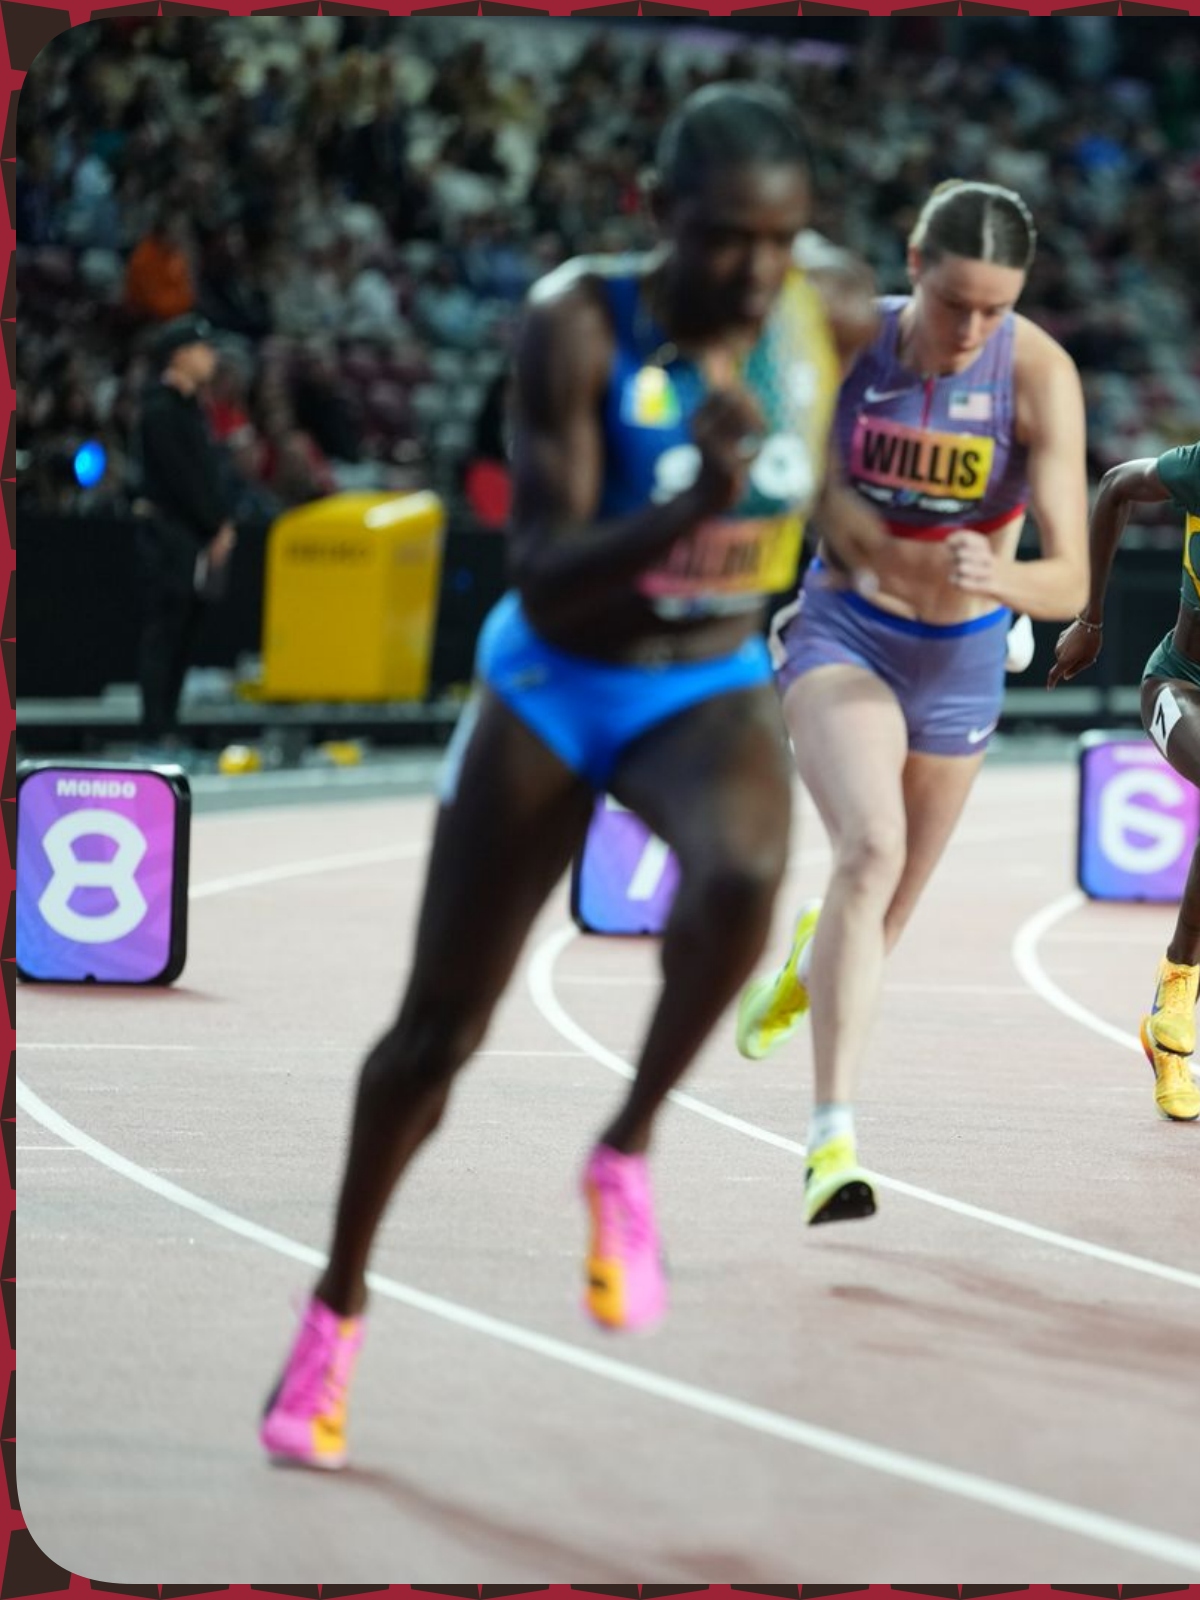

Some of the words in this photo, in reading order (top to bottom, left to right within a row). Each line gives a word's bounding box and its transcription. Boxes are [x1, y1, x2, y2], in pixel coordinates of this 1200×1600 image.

[861, 428, 980, 488] WILLIS
[56, 778, 137, 799] MONDO
[1099, 766, 1185, 874] 6
[38, 808, 148, 944] 8
